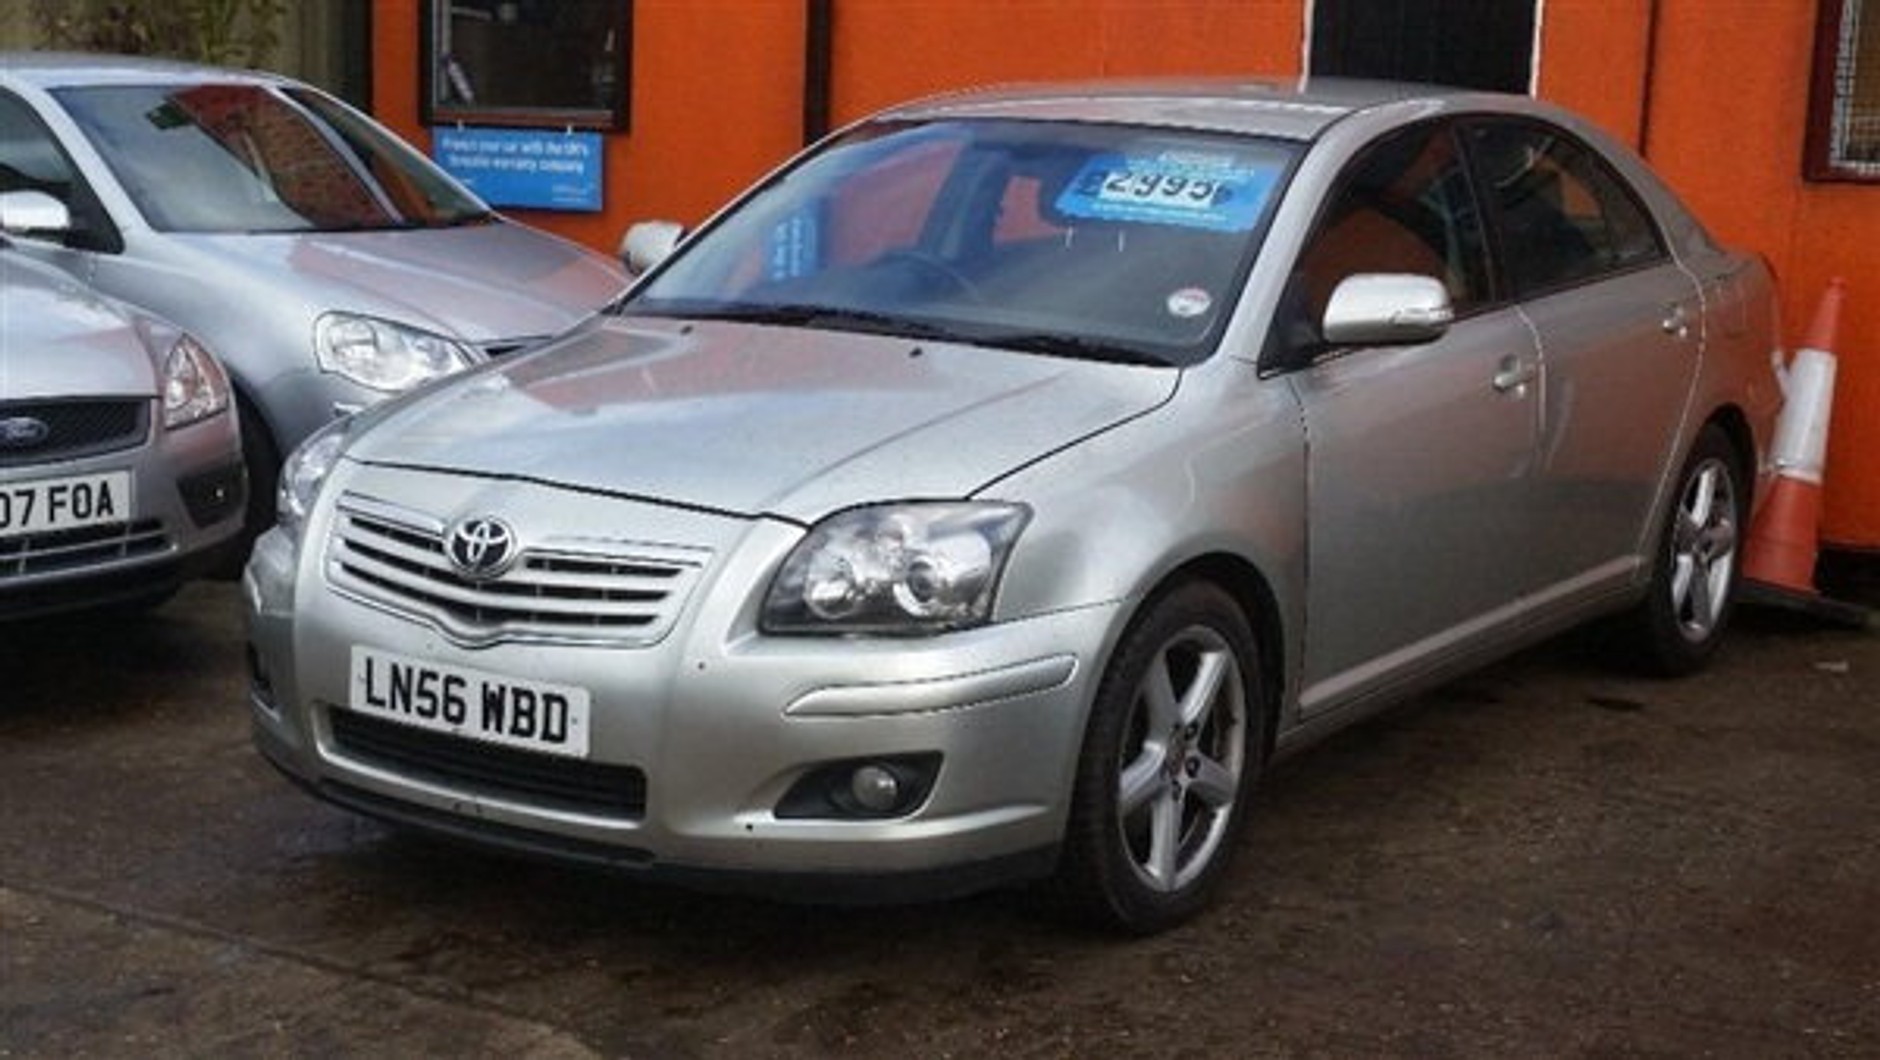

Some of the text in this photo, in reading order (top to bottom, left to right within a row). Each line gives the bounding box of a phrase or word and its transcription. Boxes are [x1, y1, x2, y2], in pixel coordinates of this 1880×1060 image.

[48, 480, 114, 523] FOA
[365, 656, 569, 745] LN56 WBD
